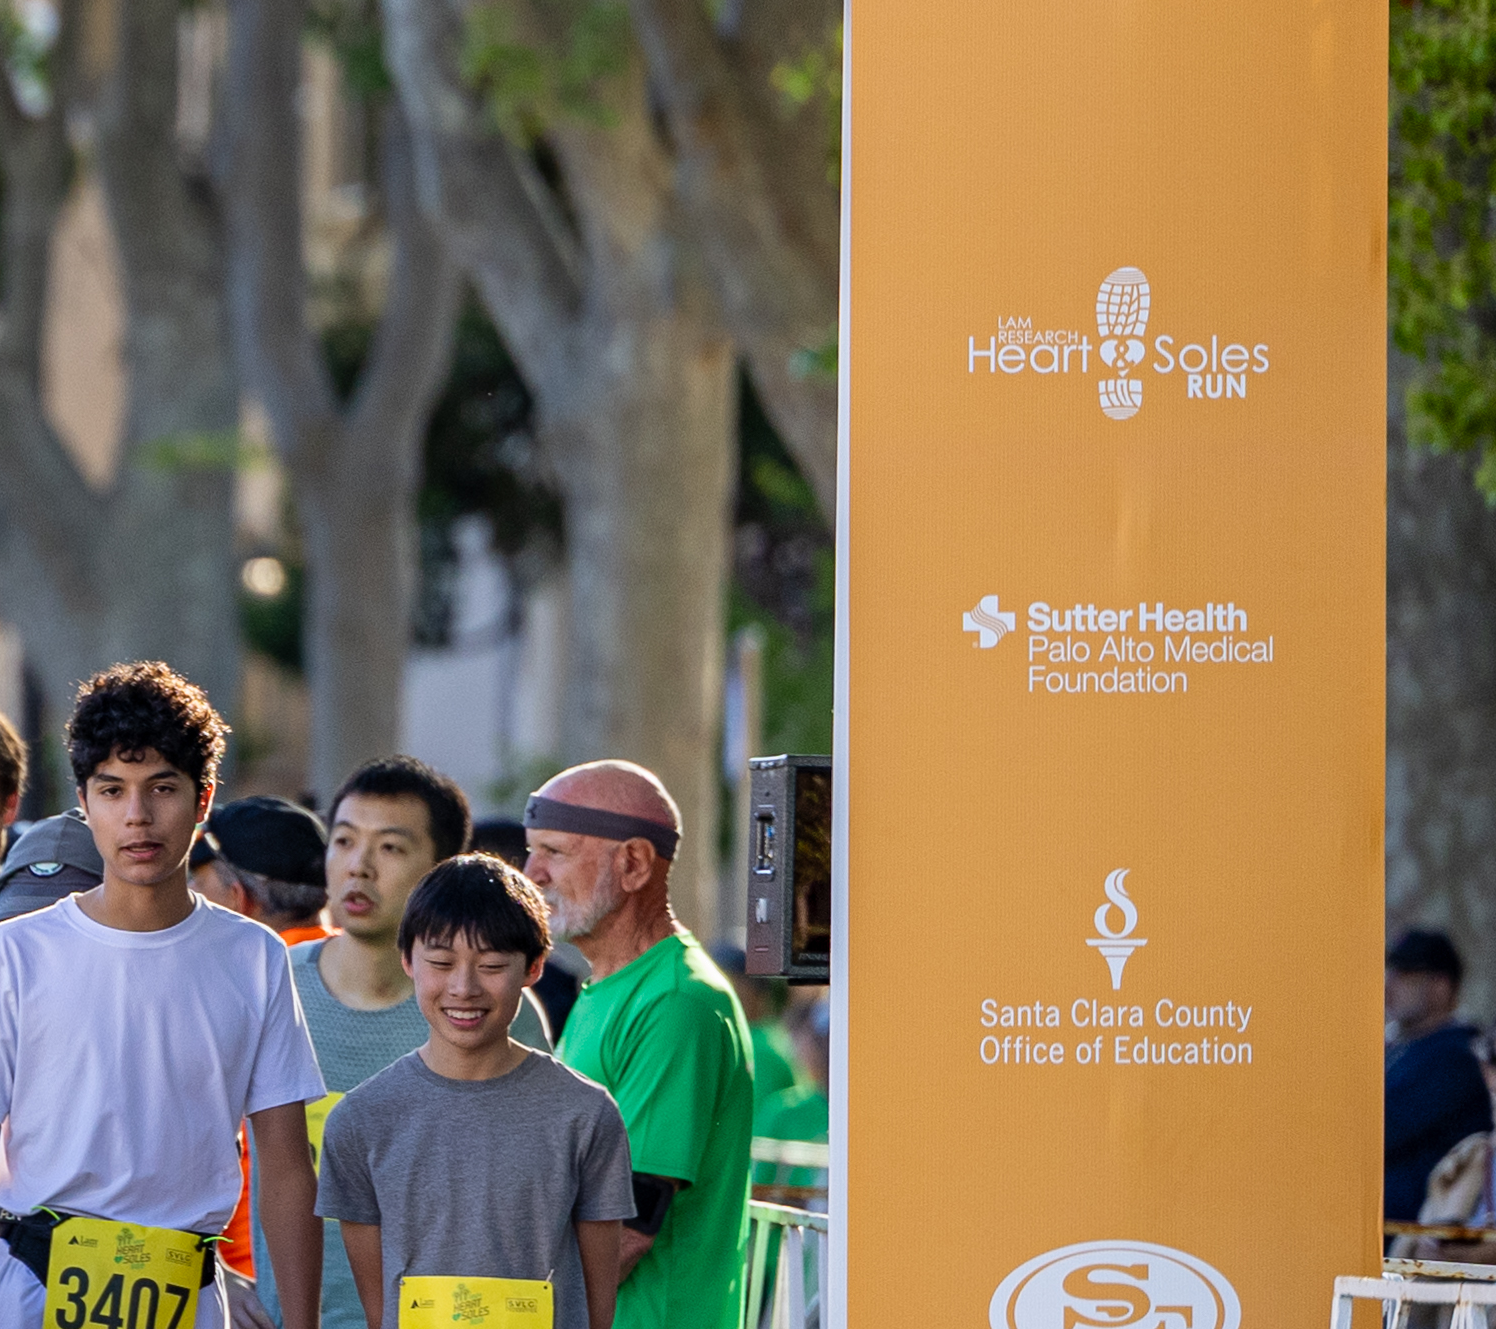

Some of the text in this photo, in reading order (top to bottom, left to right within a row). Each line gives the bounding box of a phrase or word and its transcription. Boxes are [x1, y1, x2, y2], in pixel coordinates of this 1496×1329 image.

[998, 316, 1032, 329] LAM
[998, 330, 1078, 344] RESEARCH
[968, 336, 1092, 374] Heart
[1153, 335, 1270, 374] Soles
[1187, 374, 1247, 399] RUN
[1027, 602, 1248, 633] Sutter Health
[1028, 635, 1274, 663] Palo Alto Medical
[1028, 666, 1188, 693] Foundation
[980, 998, 1254, 1033] Santa Clara County
[979, 1035, 1254, 1065] Office of Education
